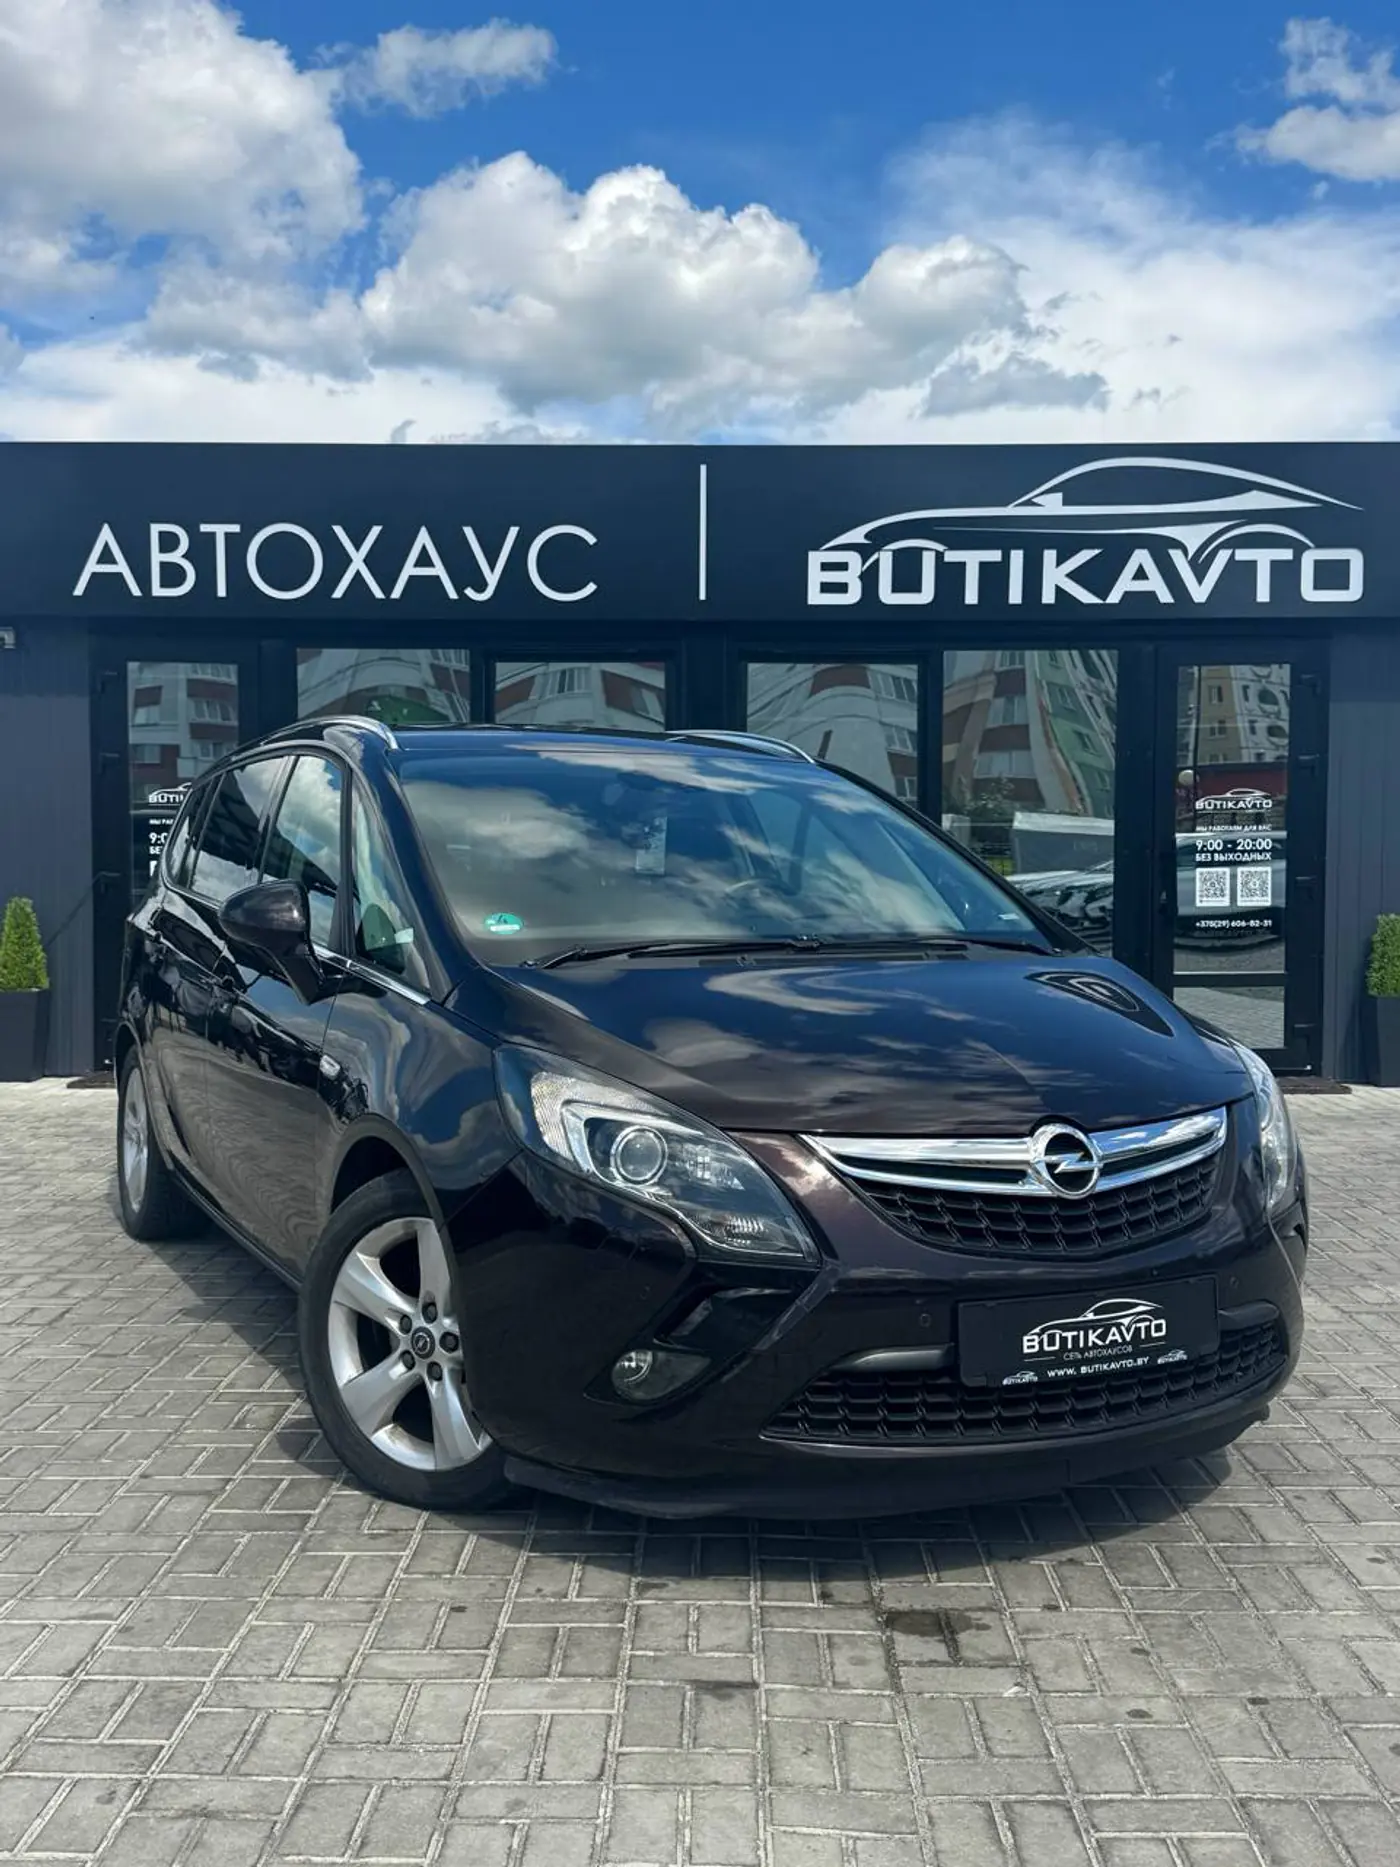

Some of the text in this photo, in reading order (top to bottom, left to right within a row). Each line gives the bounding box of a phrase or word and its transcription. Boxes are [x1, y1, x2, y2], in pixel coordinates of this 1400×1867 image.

[72, 522, 598, 602] АВТОХАУС
[806, 547, 1364, 606] BUTIKAVTO
[1195, 799, 1273, 810] BUTIKAVTO
[1196, 839, 1224, 851] 9:00
[1236, 838, 1273, 850] 20:00
[1195, 852, 1272, 861] БЕЗ ВЫХОДНЫХ
[1022, 1319, 1167, 1355] BUTIKAVTO
[1047, 1356, 1150, 1378] WWW. BUTIKAVTO.BY
